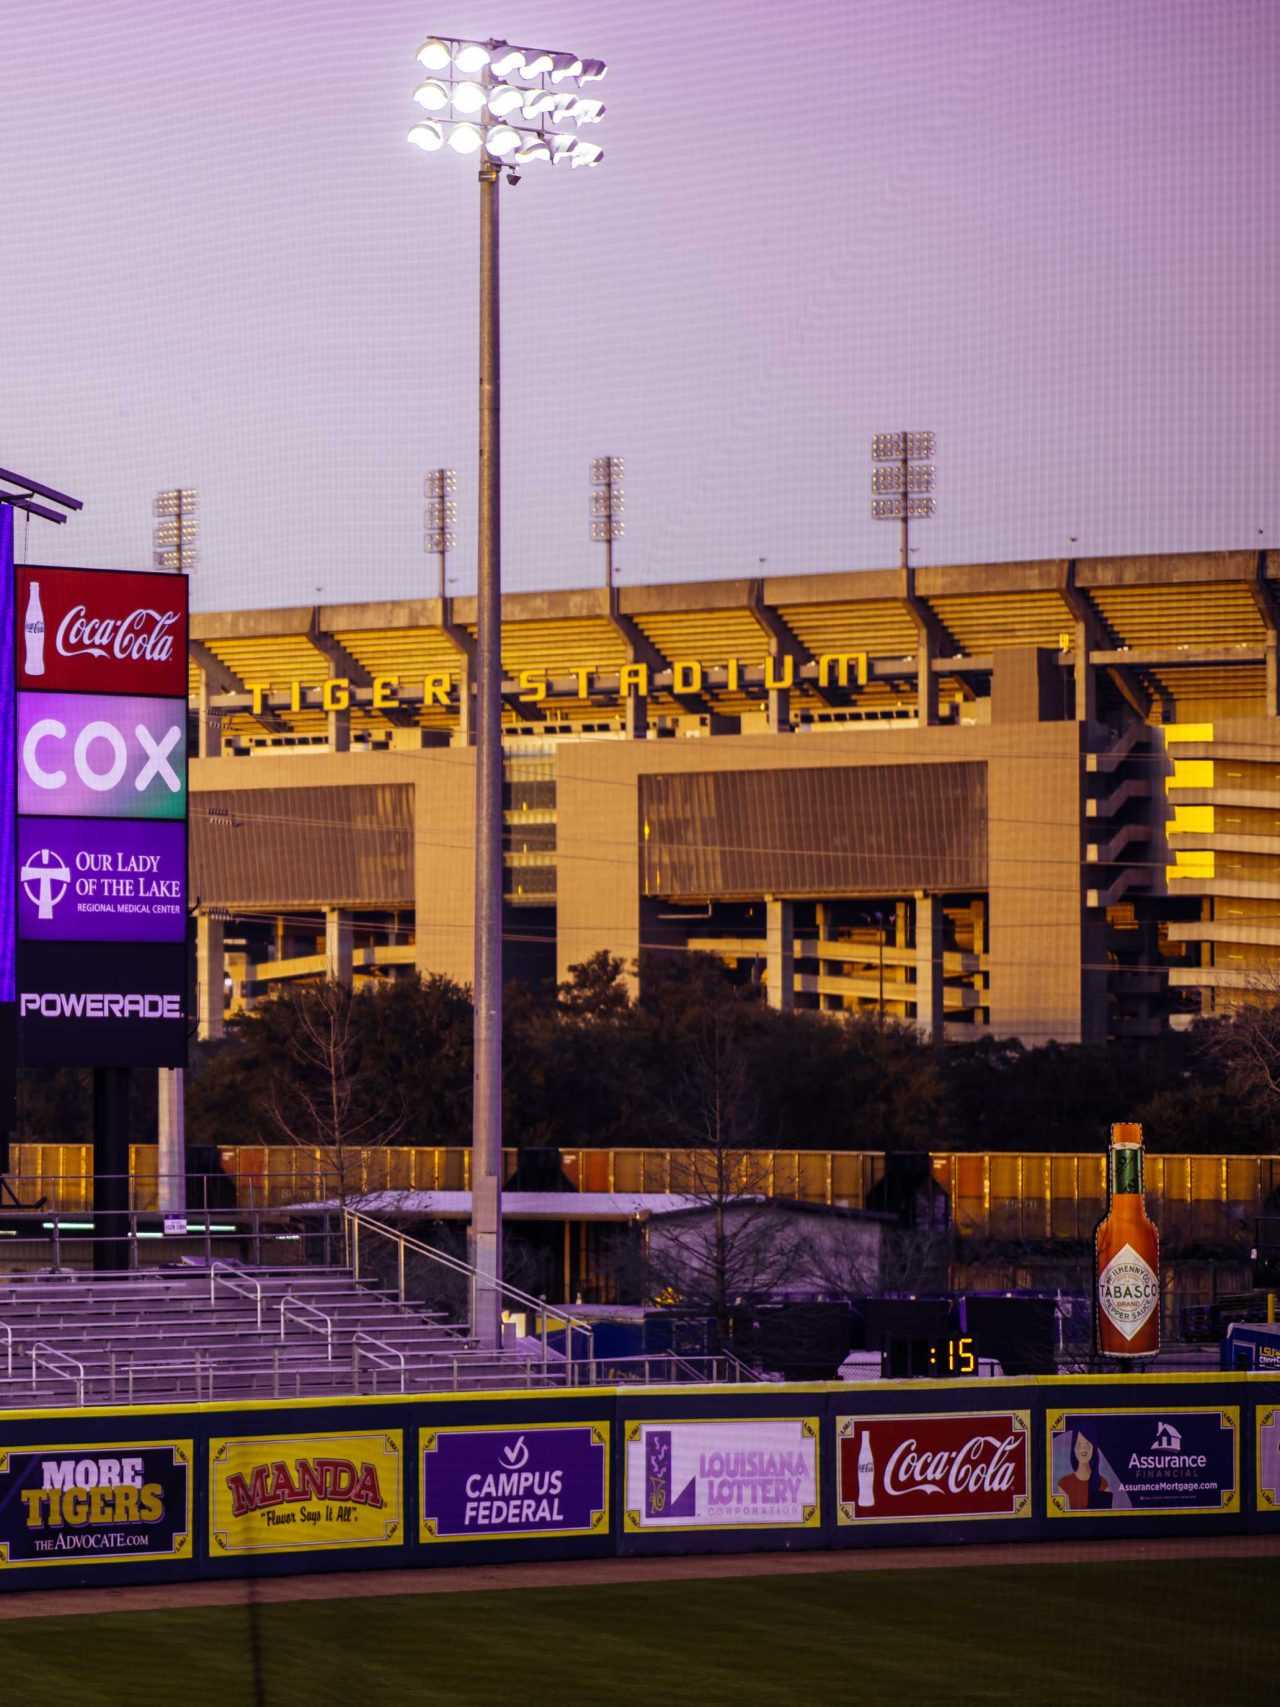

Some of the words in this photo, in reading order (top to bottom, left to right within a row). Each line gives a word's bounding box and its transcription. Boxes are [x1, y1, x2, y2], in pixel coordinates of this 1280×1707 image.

[56, 605, 180, 662] Coca-Cola
[245, 673, 454, 715] TIGER
[519, 651, 869, 704] STADIUM
[22, 718, 182, 792] COX
[76, 851, 113, 872] OUR
[117, 852, 161, 873] LADY
[76, 878, 97, 896] OF
[100, 879, 134, 897] THE
[139, 877, 181, 898] LAKE
[77, 903, 116, 913] REGIONAL
[117, 904, 151, 914] MEDICAL
[152, 904, 181, 914] CENTER
[20, 993, 181, 1018] POWERADE
[1100, 1284, 1157, 1298] TABASCO
[699, 1451, 809, 1479] LOUISIANA
[884, 1436, 1023, 1496] Coca-Cola
[1128, 1452, 1207, 1469] Assurance
[41, 1458, 144, 1492] MORE
[226, 1457, 384, 1517] MANDA
[465, 1470, 563, 1498] CAMPUS
[1119, 1481, 1218, 1492] AssuranceMortgage.com
[708, 1478, 801, 1505] LOTTERY
[21, 1483, 166, 1529] TIGERS
[300, 1506, 321, 1525] Says
[325, 1505, 333, 1522] It
[464, 1498, 564, 1525] FEDERAL
